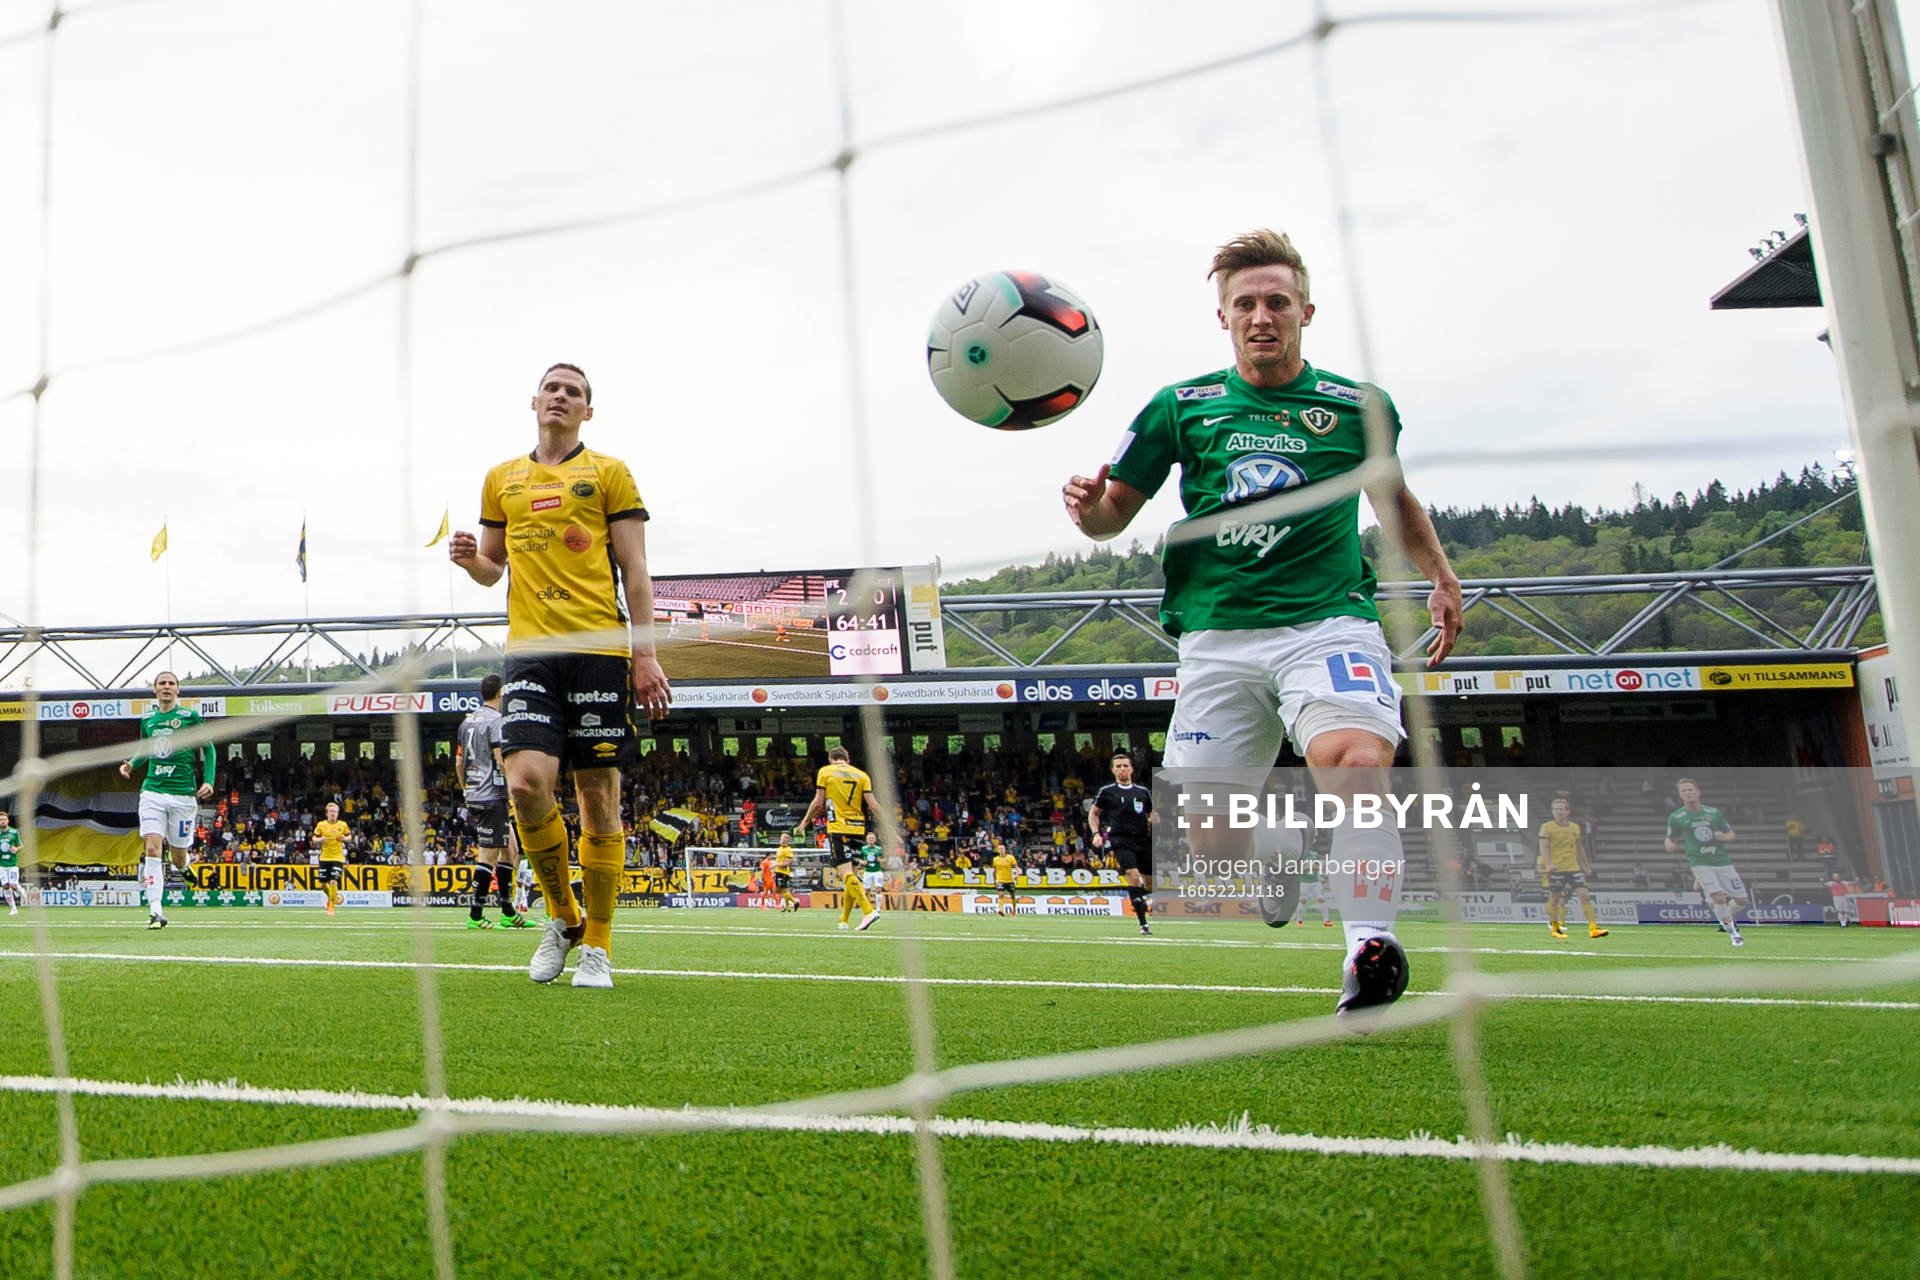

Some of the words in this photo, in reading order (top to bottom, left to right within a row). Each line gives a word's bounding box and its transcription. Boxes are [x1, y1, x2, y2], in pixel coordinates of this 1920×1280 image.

[1228, 435, 1306, 451] Atteviks
[1216, 521, 1291, 558] EVRY
[536, 585, 572, 601] ellos
[836, 589, 848, 605] 2
[874, 590, 885, 605] 0
[836, 613, 887, 631] 64:41
[849, 643, 898, 656] cadcraft
[1567, 671, 1611, 690] net
[1619, 675, 1639, 685] on
[1646, 668, 1692, 688] net
[1738, 673, 1751, 681] VI
[1755, 670, 1847, 681] TILLSAMMANS
[771, 690, 822, 700] Swedbank
[825, 688, 869, 701] Sjuhärad
[892, 687, 945, 698] Swedbank
[947, 686, 993, 699] Sjuhärad
[1024, 680, 1072, 700] ellos
[1088, 678, 1137, 699] ellos
[333, 694, 426, 712] PULSEN
[439, 693, 480, 711] ellos
[843, 780, 857, 805] 7
[198, 866, 378, 891] GULIGANENA
[42, 892, 78, 905] TIPS
[95, 892, 131, 905] ELIT
[1478, 905, 1512, 915] UBAB
[1601, 906, 1635, 916] UBAB
